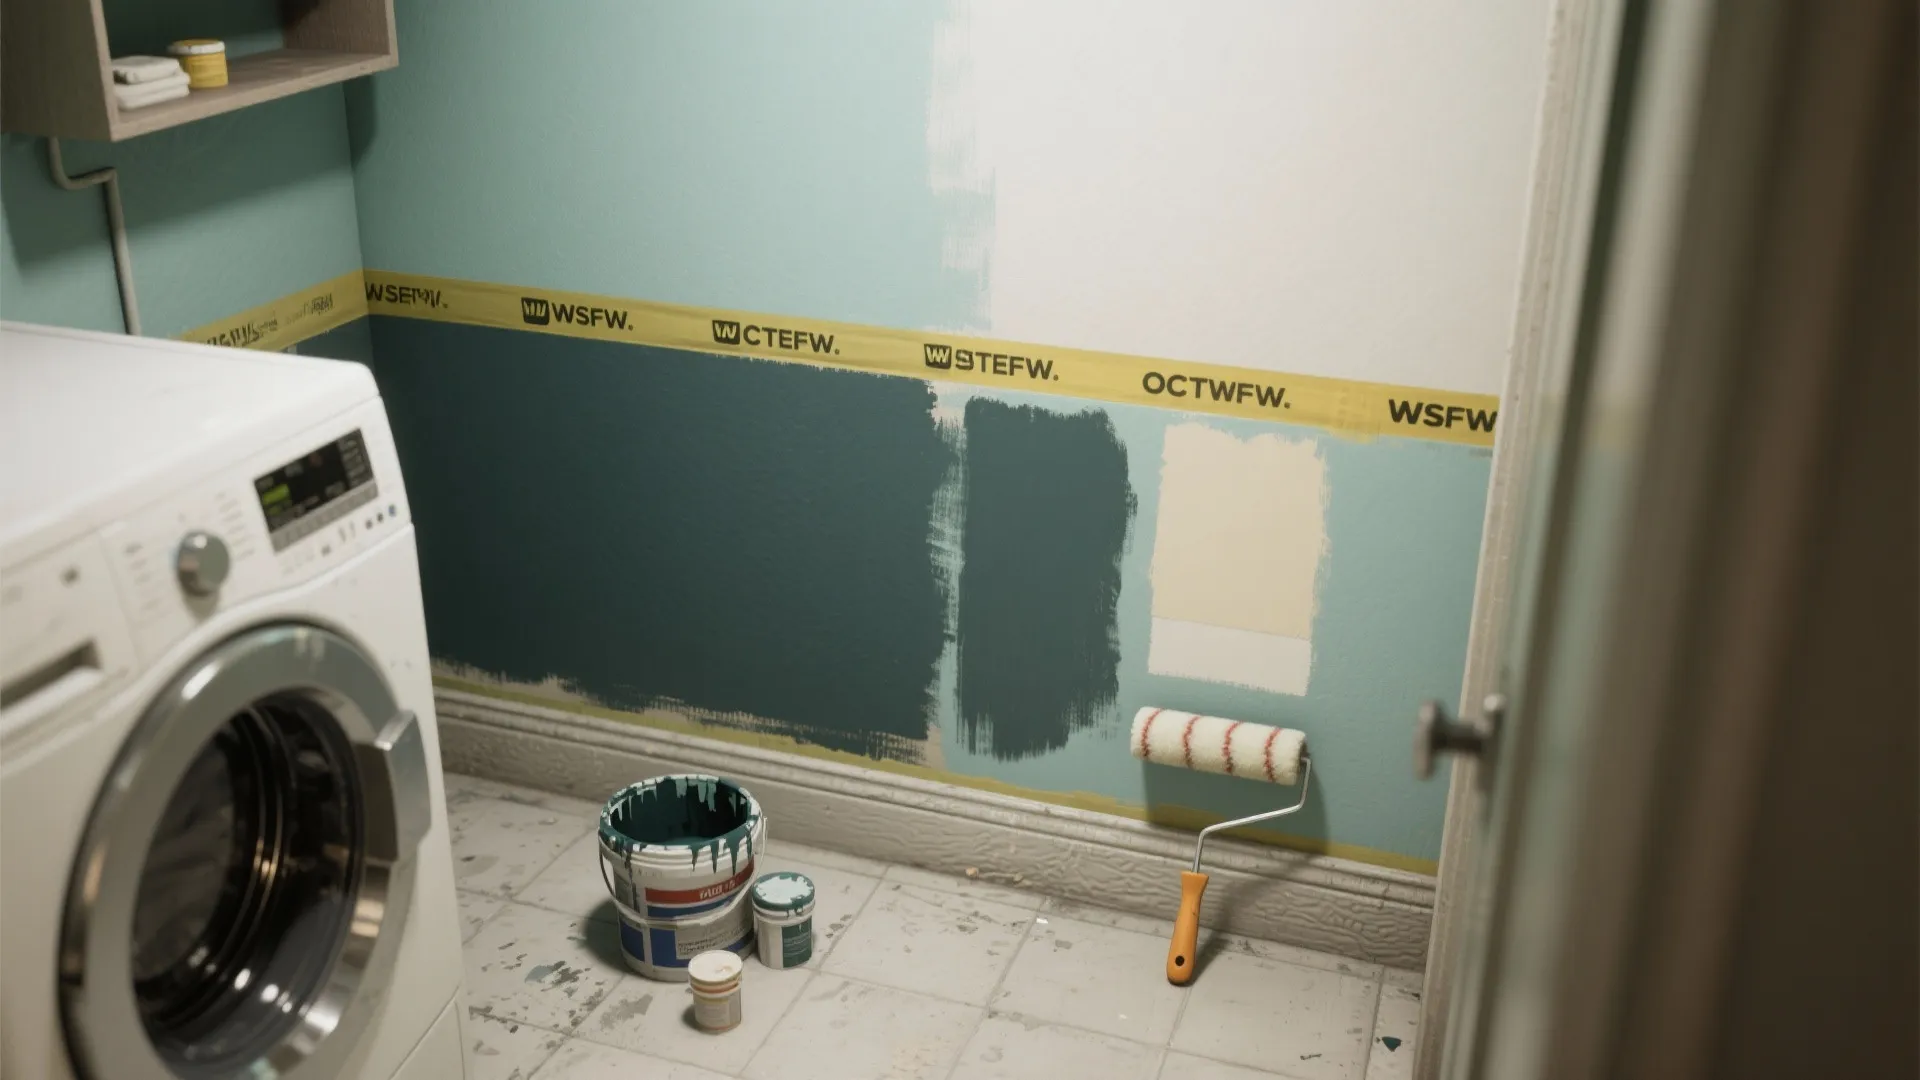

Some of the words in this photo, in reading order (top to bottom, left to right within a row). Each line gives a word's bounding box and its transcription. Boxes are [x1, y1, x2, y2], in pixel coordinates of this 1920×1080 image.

[743, 324, 840, 355] CTEFW.
[1142, 371, 1291, 409] OCTWFW.
[1388, 398, 1498, 433] WSFW
